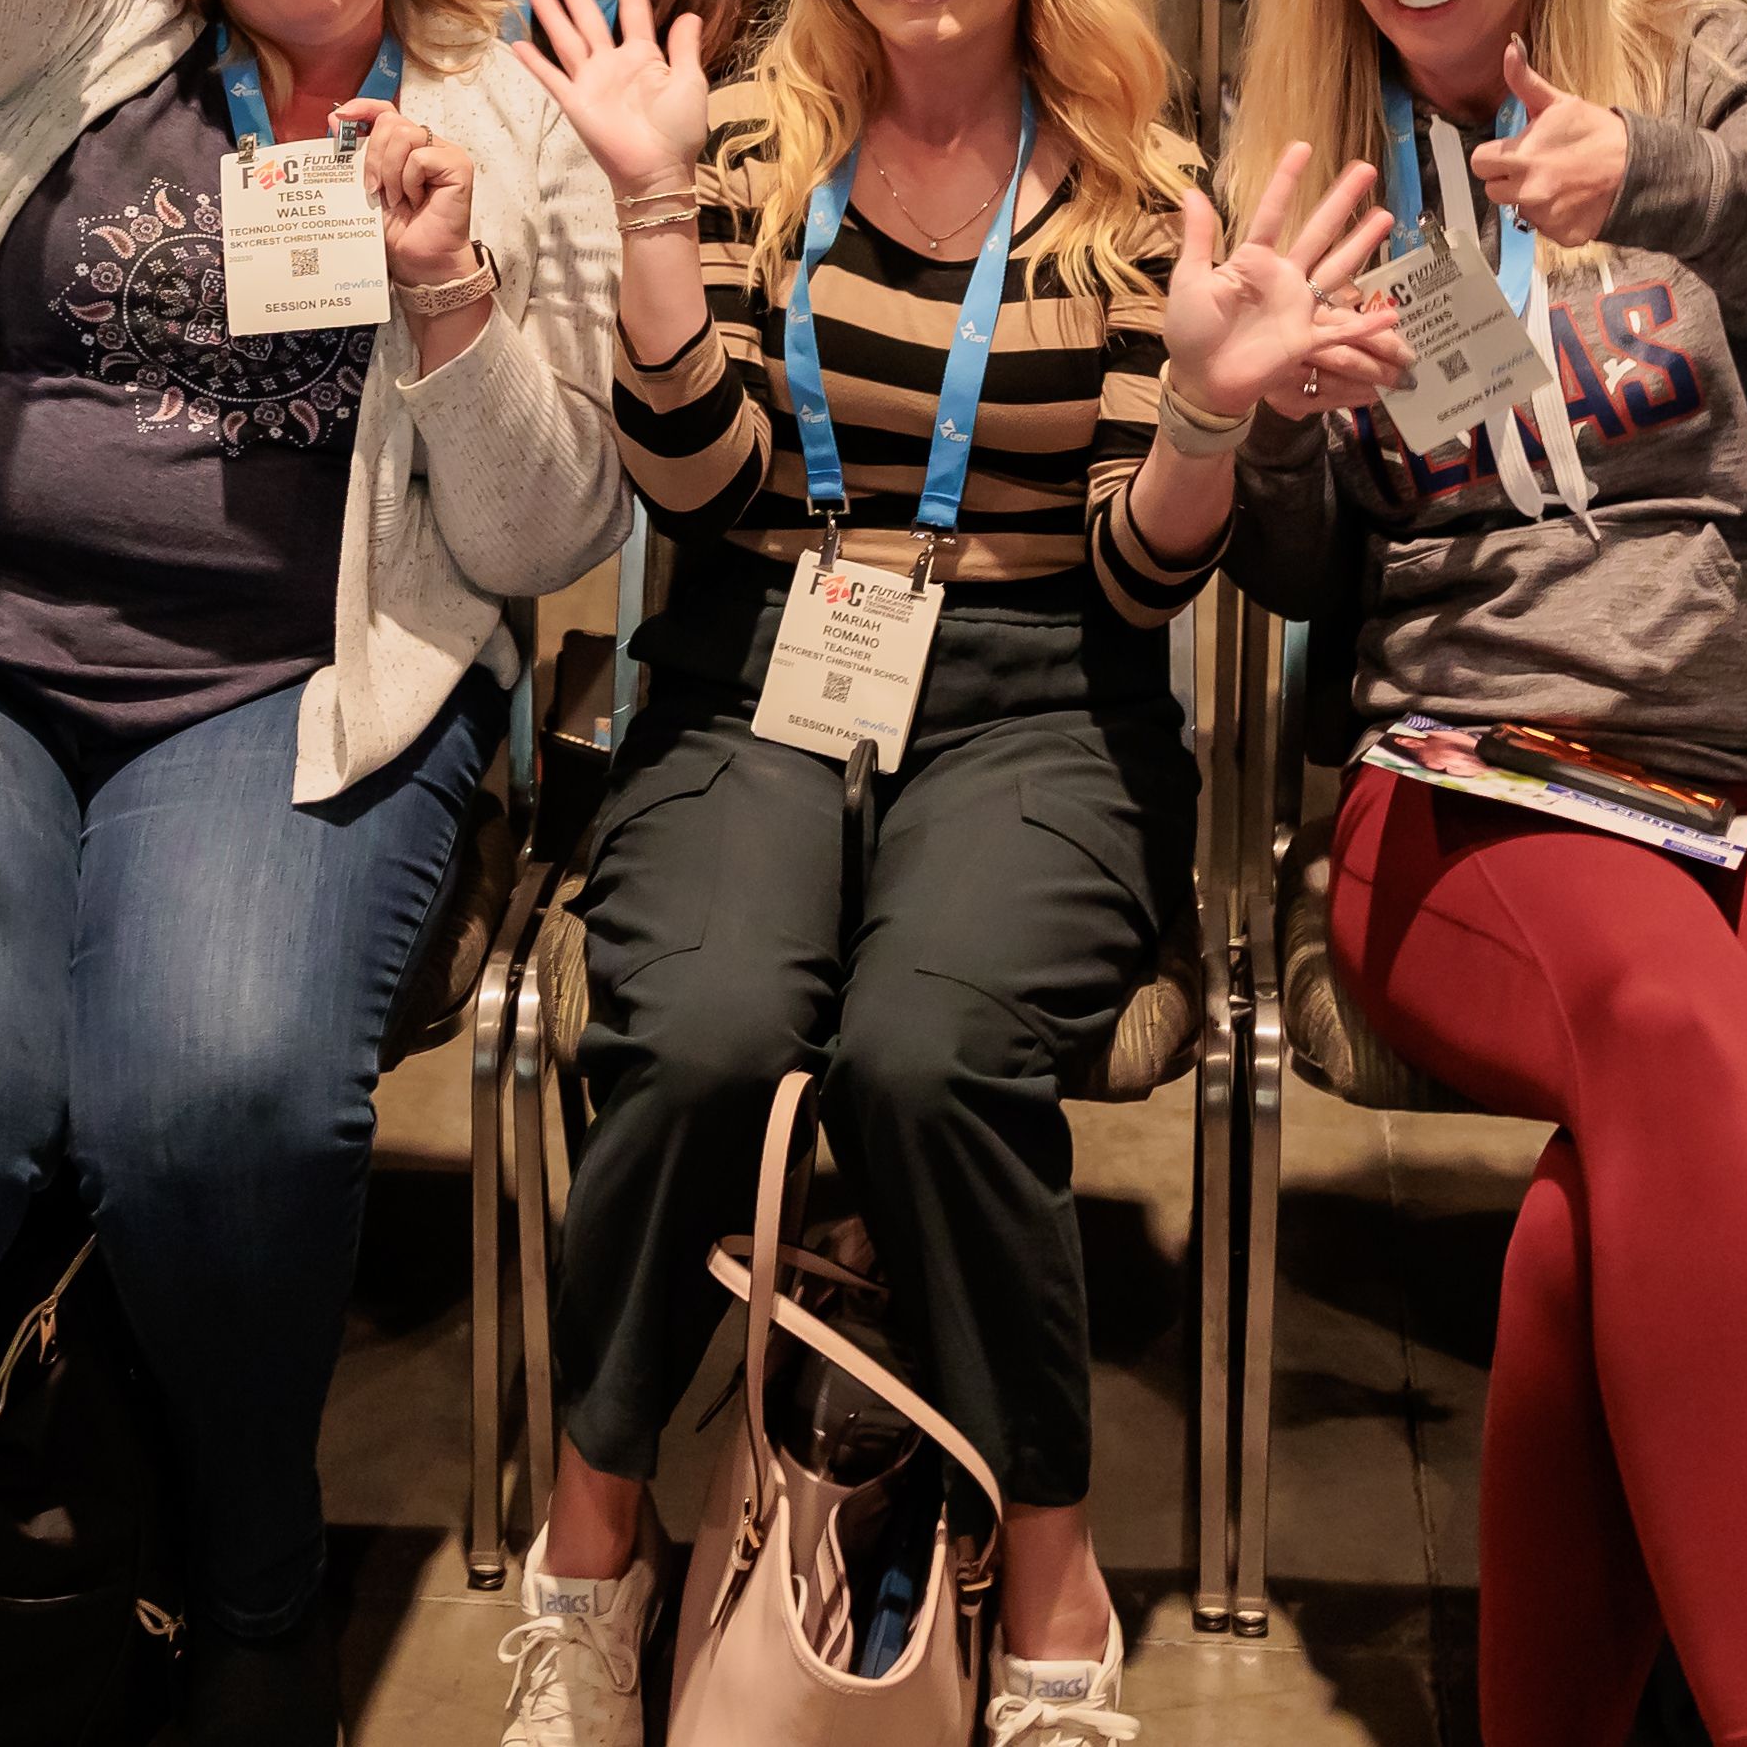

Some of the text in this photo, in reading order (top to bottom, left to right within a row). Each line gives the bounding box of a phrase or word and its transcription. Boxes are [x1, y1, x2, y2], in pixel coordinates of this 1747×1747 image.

[303, 154, 353, 167] FUTURE
[311, 164, 354, 172] EDUCATION
[303, 177, 355, 185] CONFERENCE
[278, 190, 324, 202] TESSA
[276, 205, 326, 219] WALES
[229, 217, 377, 237] TECHNOLOGY COORDINATOR
[230, 230, 377, 250] SKYCREST CHRISTIAN SCHOOL
[334, 278, 383, 291] newline
[265, 297, 352, 313] SESSION PASS
[831, 610, 882, 632] MARIAH
[822, 625, 880, 649] ROMANO
[823, 641, 872, 662] TEACHER
[778, 642, 910, 686] SKYCREST CHRISTIAN SCHOOL
[787, 714, 834, 736] SESSION
[545, 1591, 591, 1615] asics
[1034, 1676, 1085, 1699] asics
